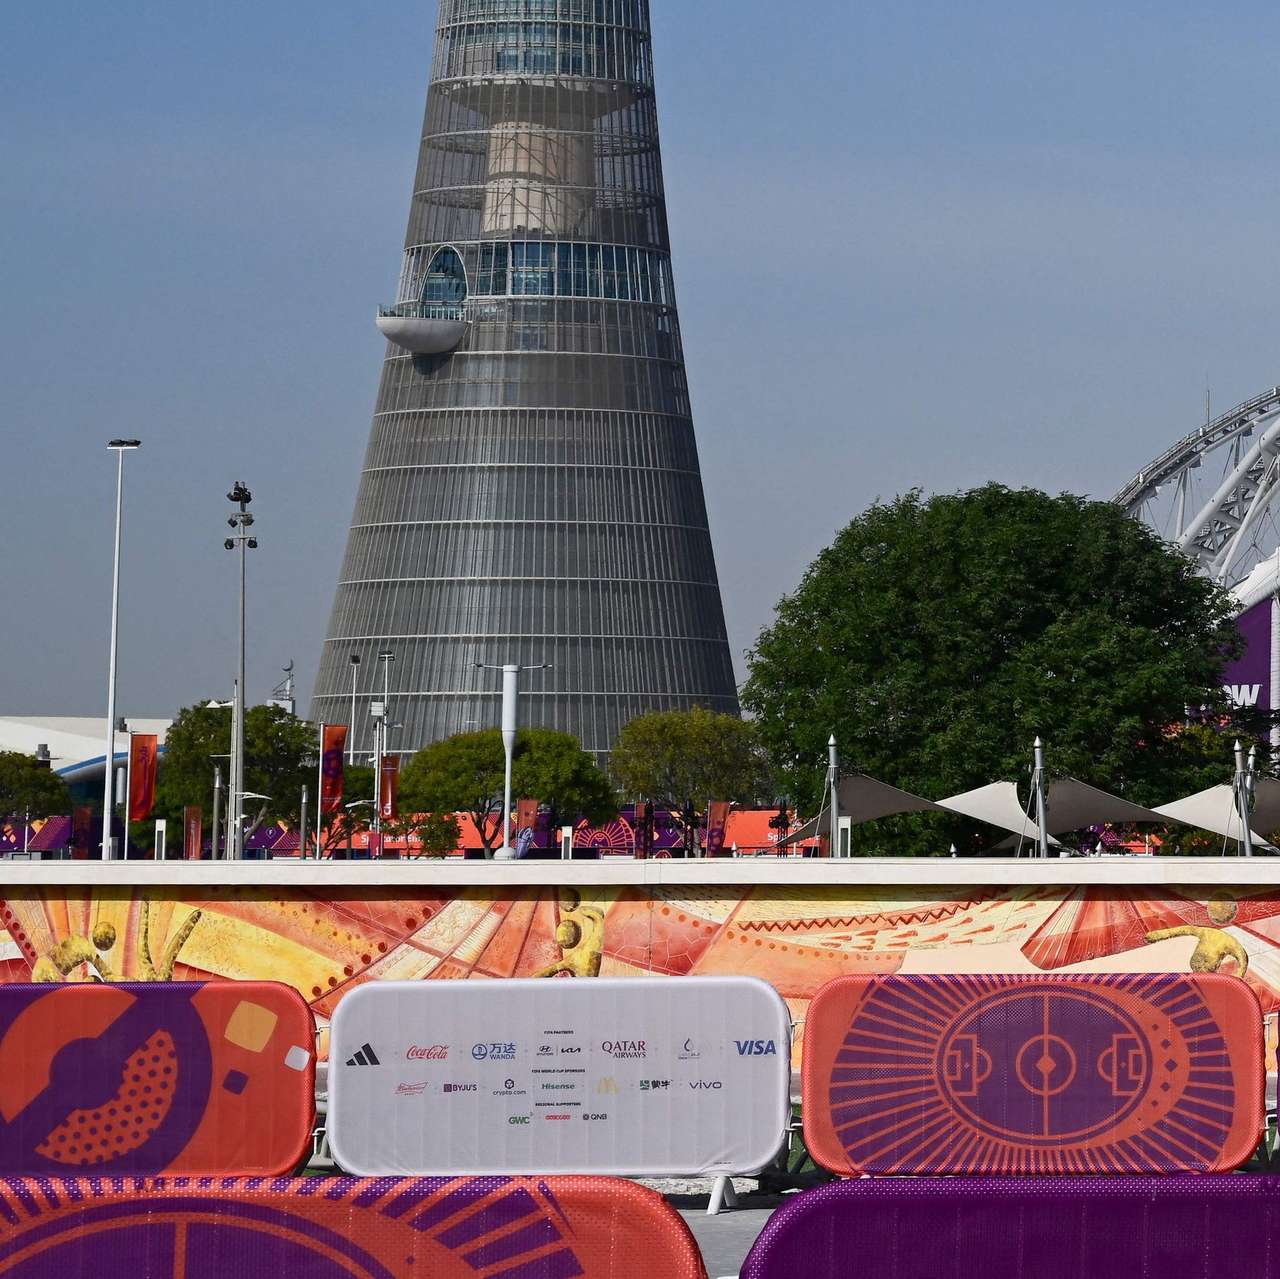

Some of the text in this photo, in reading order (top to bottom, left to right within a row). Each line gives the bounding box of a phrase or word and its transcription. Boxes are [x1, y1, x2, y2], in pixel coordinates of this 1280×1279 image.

[406, 1044, 449, 1060] Coca-Cola
[490, 1042, 516, 1054] 万达
[602, 1040, 646, 1052] QATAR
[734, 1040, 776, 1056] VISA
[452, 1084, 477, 1092] BYJU'S
[689, 1080, 722, 1089] vivo
[508, 1116, 530, 1124] GWC
